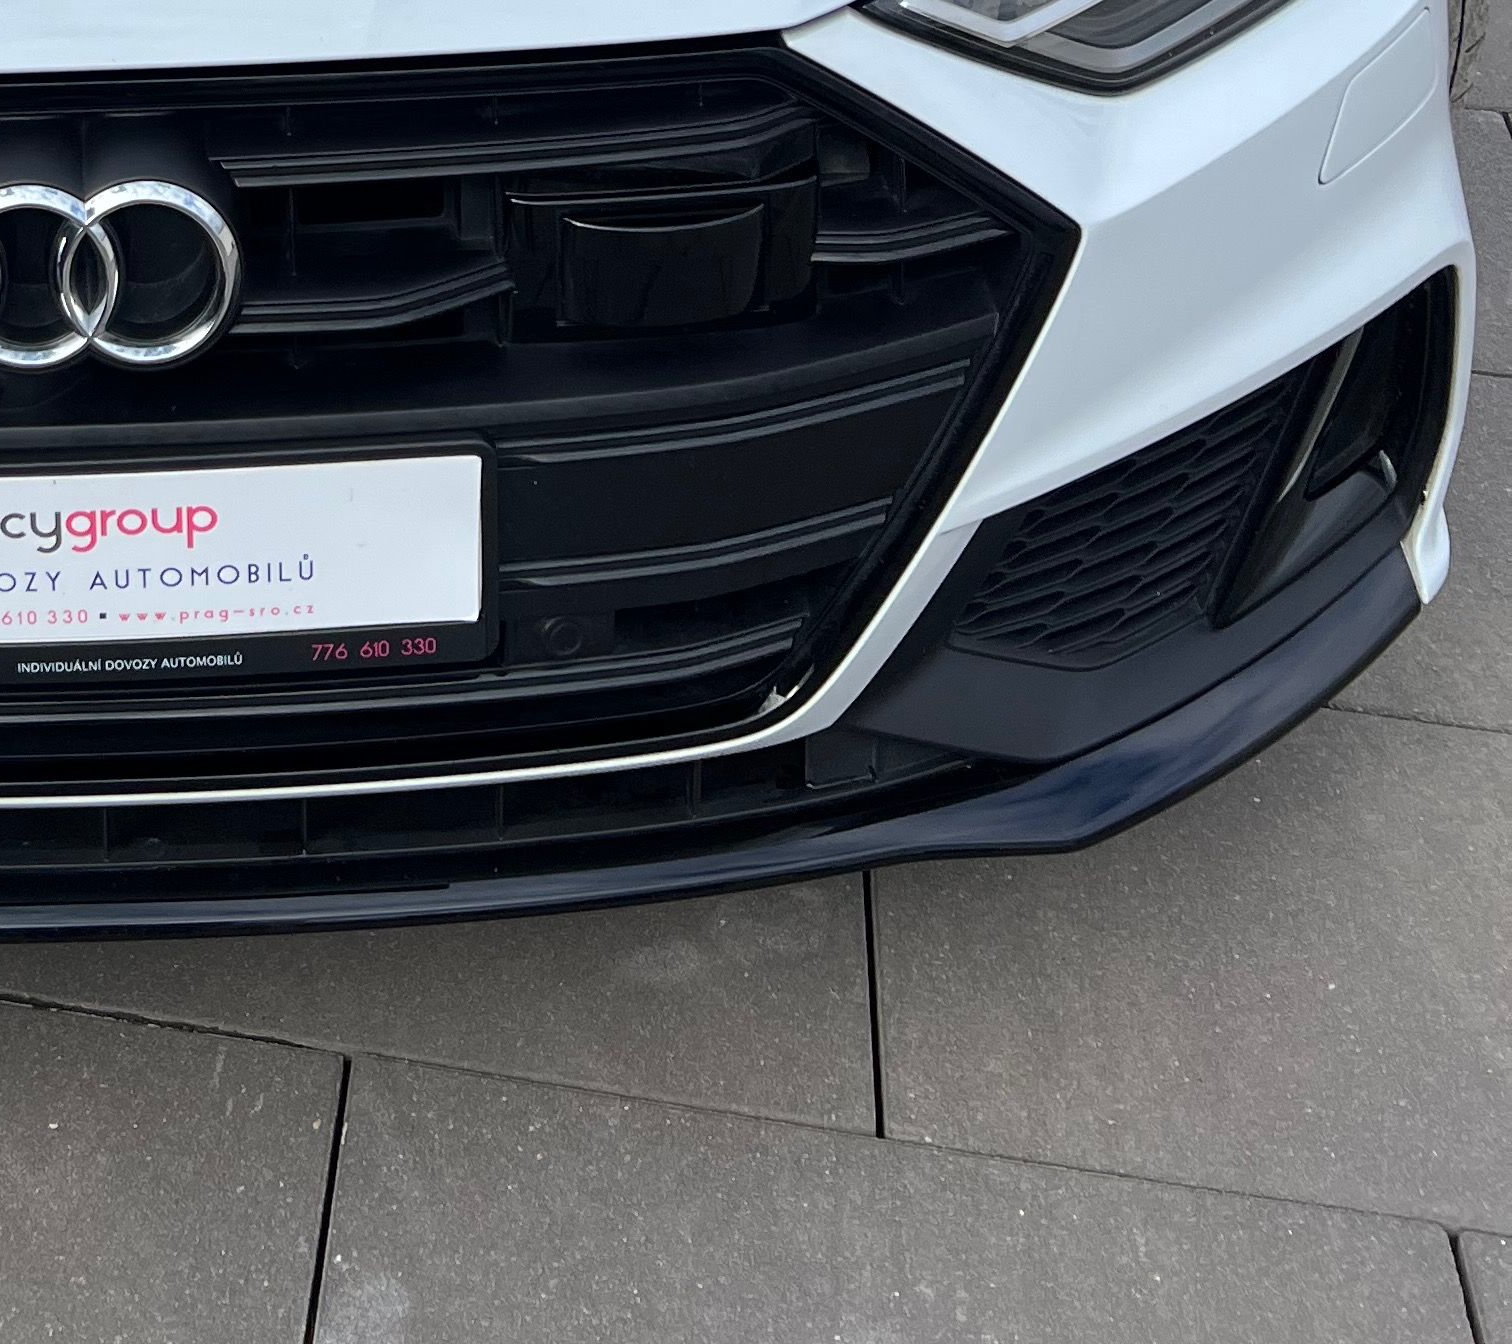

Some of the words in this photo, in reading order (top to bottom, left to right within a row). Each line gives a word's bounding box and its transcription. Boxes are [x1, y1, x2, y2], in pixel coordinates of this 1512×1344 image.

[89, 553, 315, 591] AUTOMOBILŮ
[1, 609, 38, 626] 610
[47, 608, 89, 625] 330
[311, 643, 349, 661] 776
[359, 639, 390, 658] 610
[400, 637, 438, 656] 330
[16, 658, 103, 674] INDIVIDUÁLNÍ
[105, 657, 159, 672] DOVOZY
[160, 650, 244, 670] AUTOMOBILŮ
